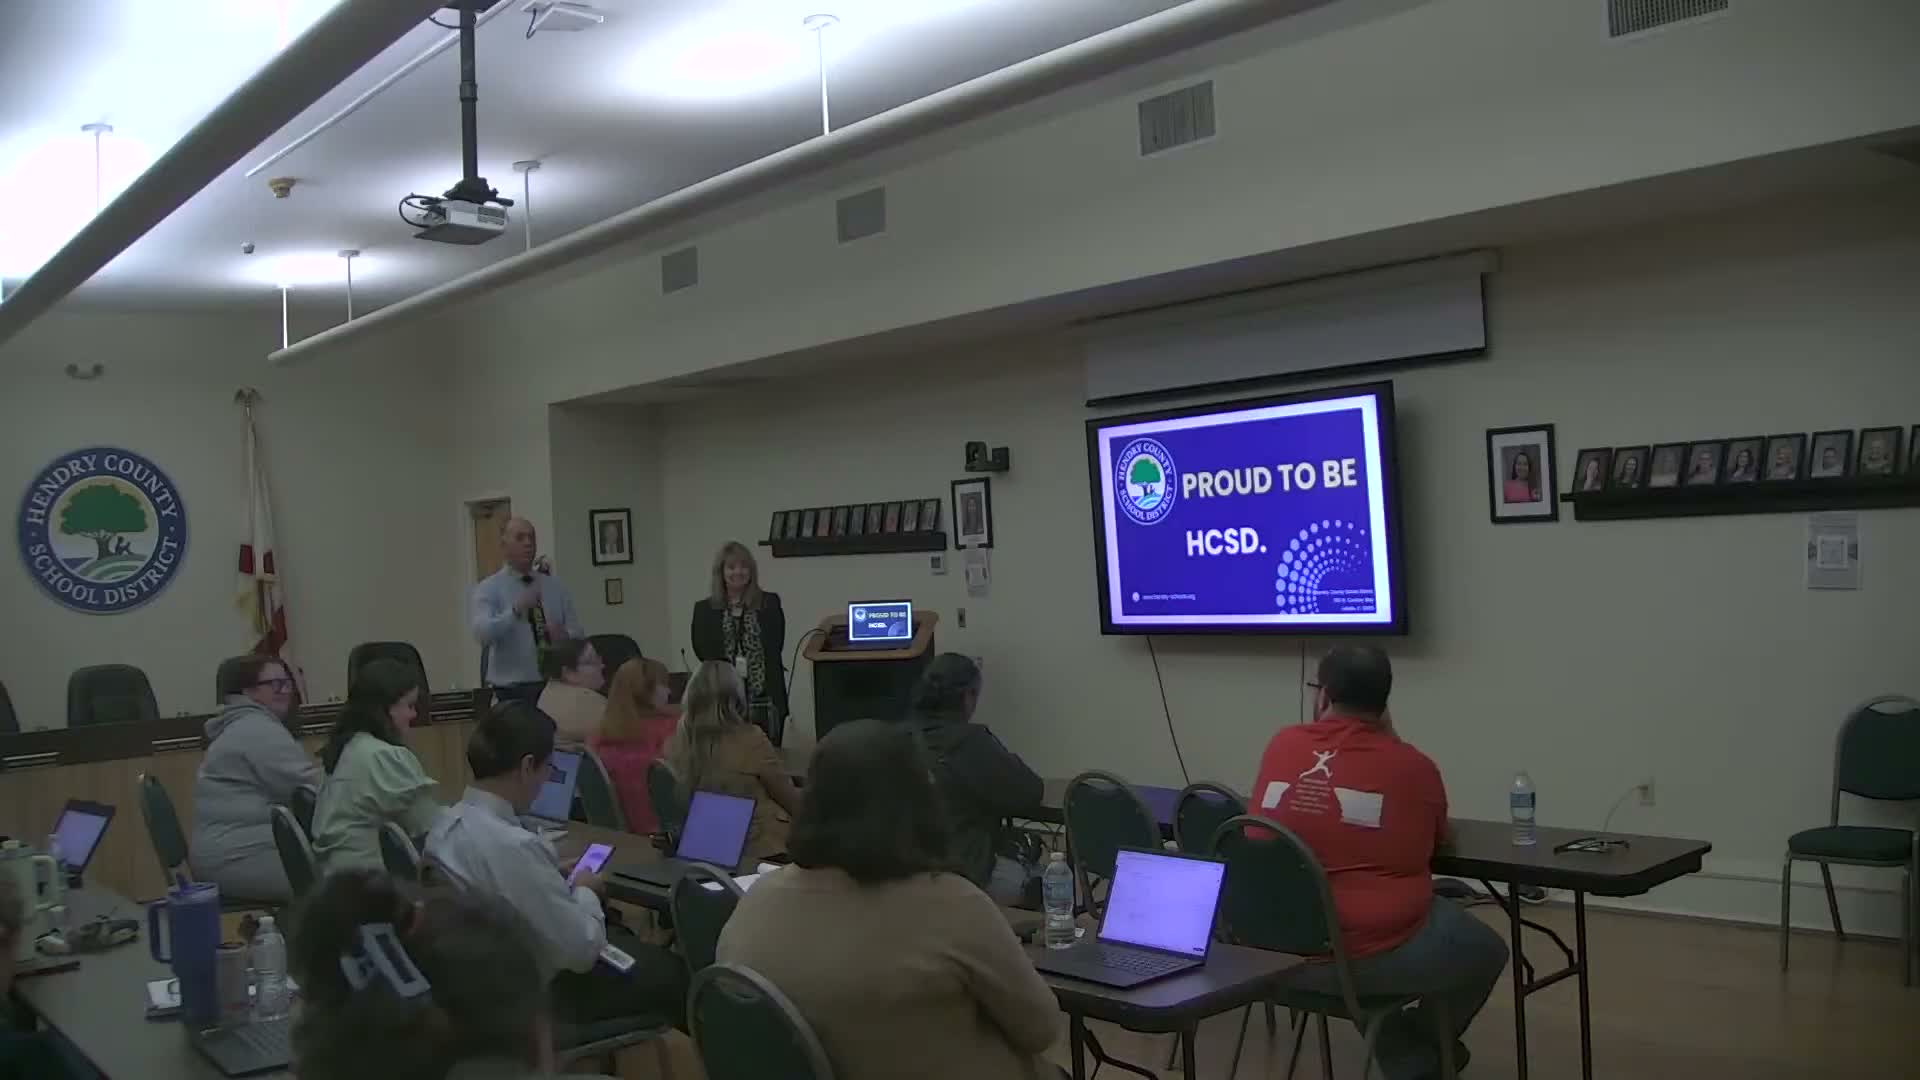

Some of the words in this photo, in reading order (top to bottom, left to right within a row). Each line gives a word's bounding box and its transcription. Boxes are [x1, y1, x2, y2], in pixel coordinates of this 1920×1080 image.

[1118, 442, 1143, 481] HENDRY
[1143, 442, 1173, 475] COUNTY
[1182, 466, 1272, 499] PROUD
[1277, 462, 1316, 491] TO
[1322, 458, 1357, 488] BE
[26, 454, 97, 525] HENDRY
[103, 454, 178, 518] COUNTY
[1186, 527, 1267, 556] HCSD.
[29, 543, 99, 604] SCHOOL
[103, 536, 178, 605] DISTRICT
